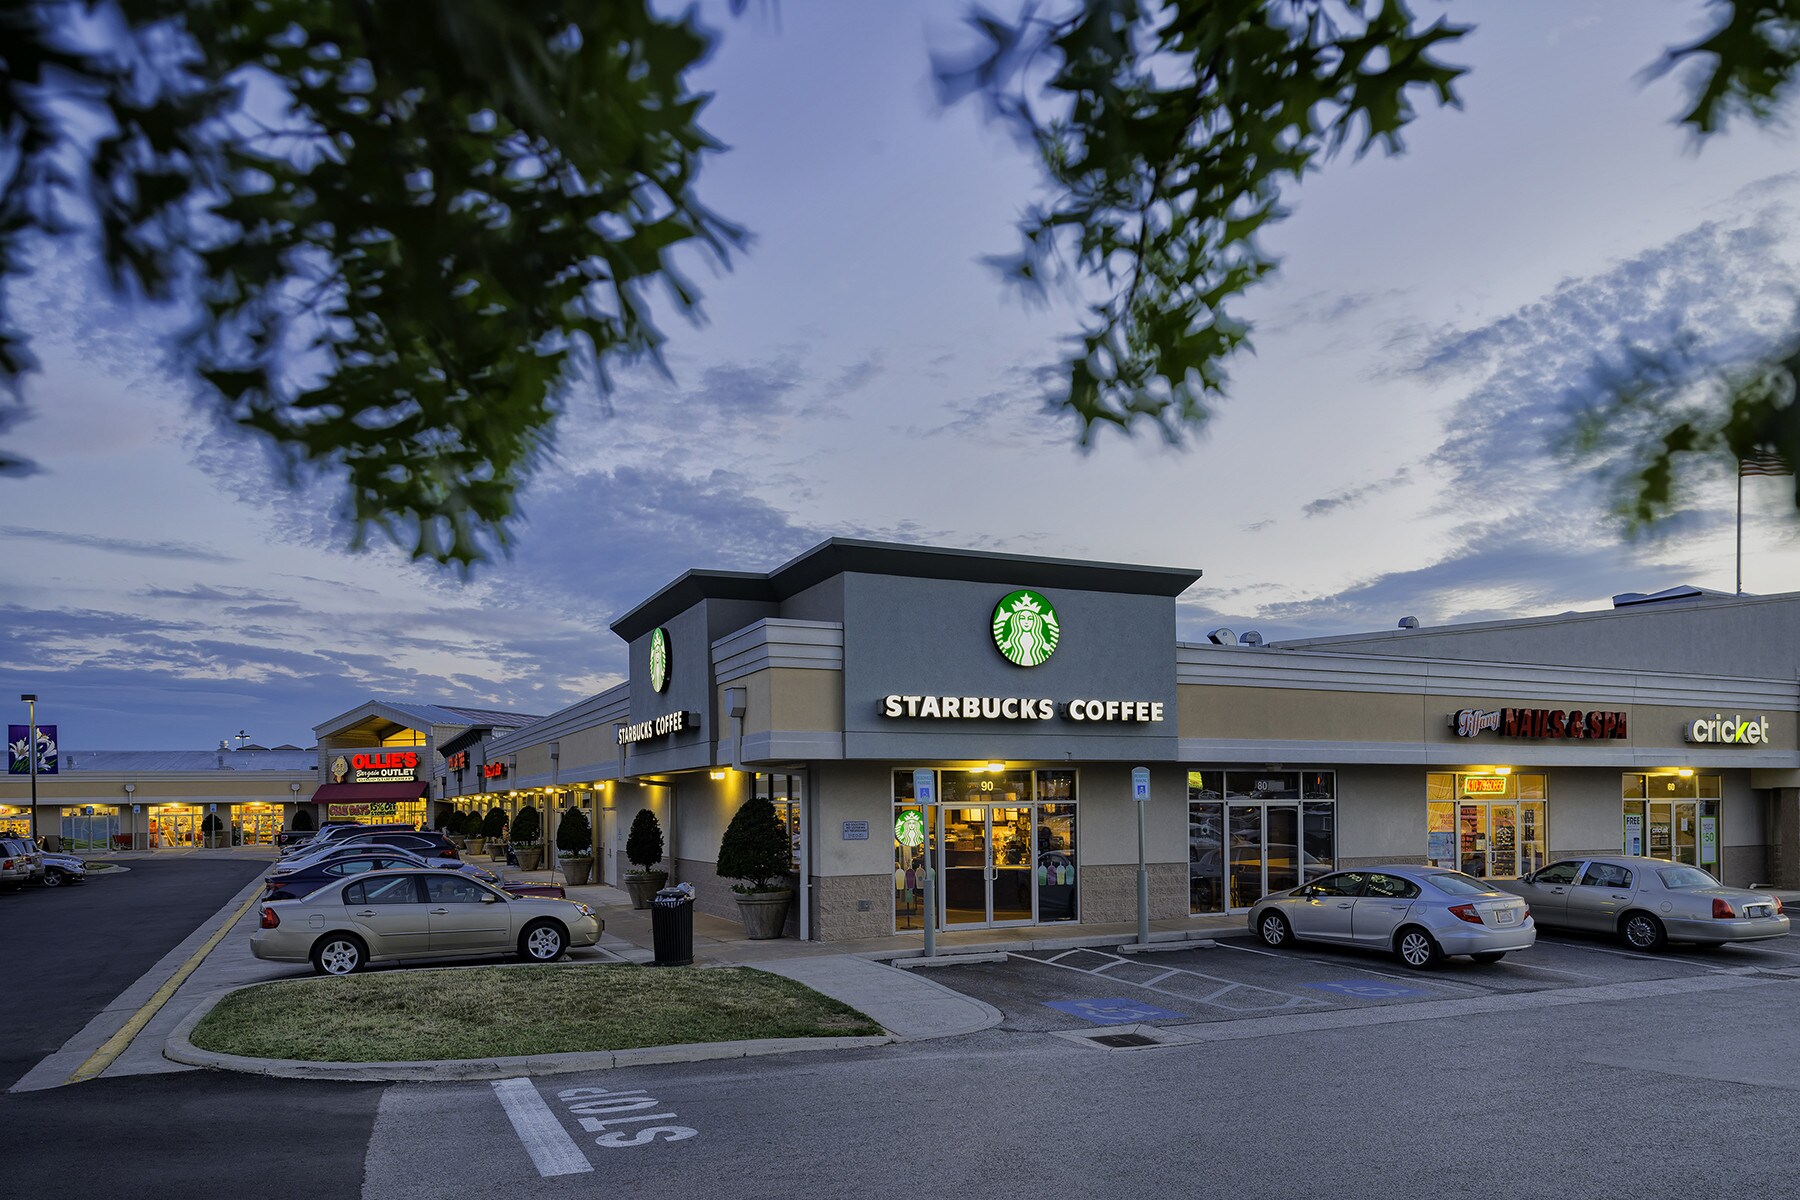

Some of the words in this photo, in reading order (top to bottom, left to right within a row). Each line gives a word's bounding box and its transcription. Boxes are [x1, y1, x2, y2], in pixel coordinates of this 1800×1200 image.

[885, 695, 1054, 720] STARBUCKS
[1069, 699, 1164, 722] COFFEE
[618, 720, 652, 744] STARBUCKS
[656, 711, 682, 735] COFFEE
[1458, 708, 1500, 738] Tiffany
[1502, 708, 1566, 739] NAILS
[1568, 710, 1585, 739] &
[1590, 711, 1628, 740] SPA
[1692, 713, 1769, 744] cricket
[352, 752, 417, 769] OLLIE'S
[381, 768, 415, 777] OUTLET
[980, 780, 994, 792] 90
[1257, 781, 1268, 791] 80
[1667, 783, 1675, 791] 60
[1626, 816, 1640, 825] FREE
[557, 1087, 699, 1148] STOP
